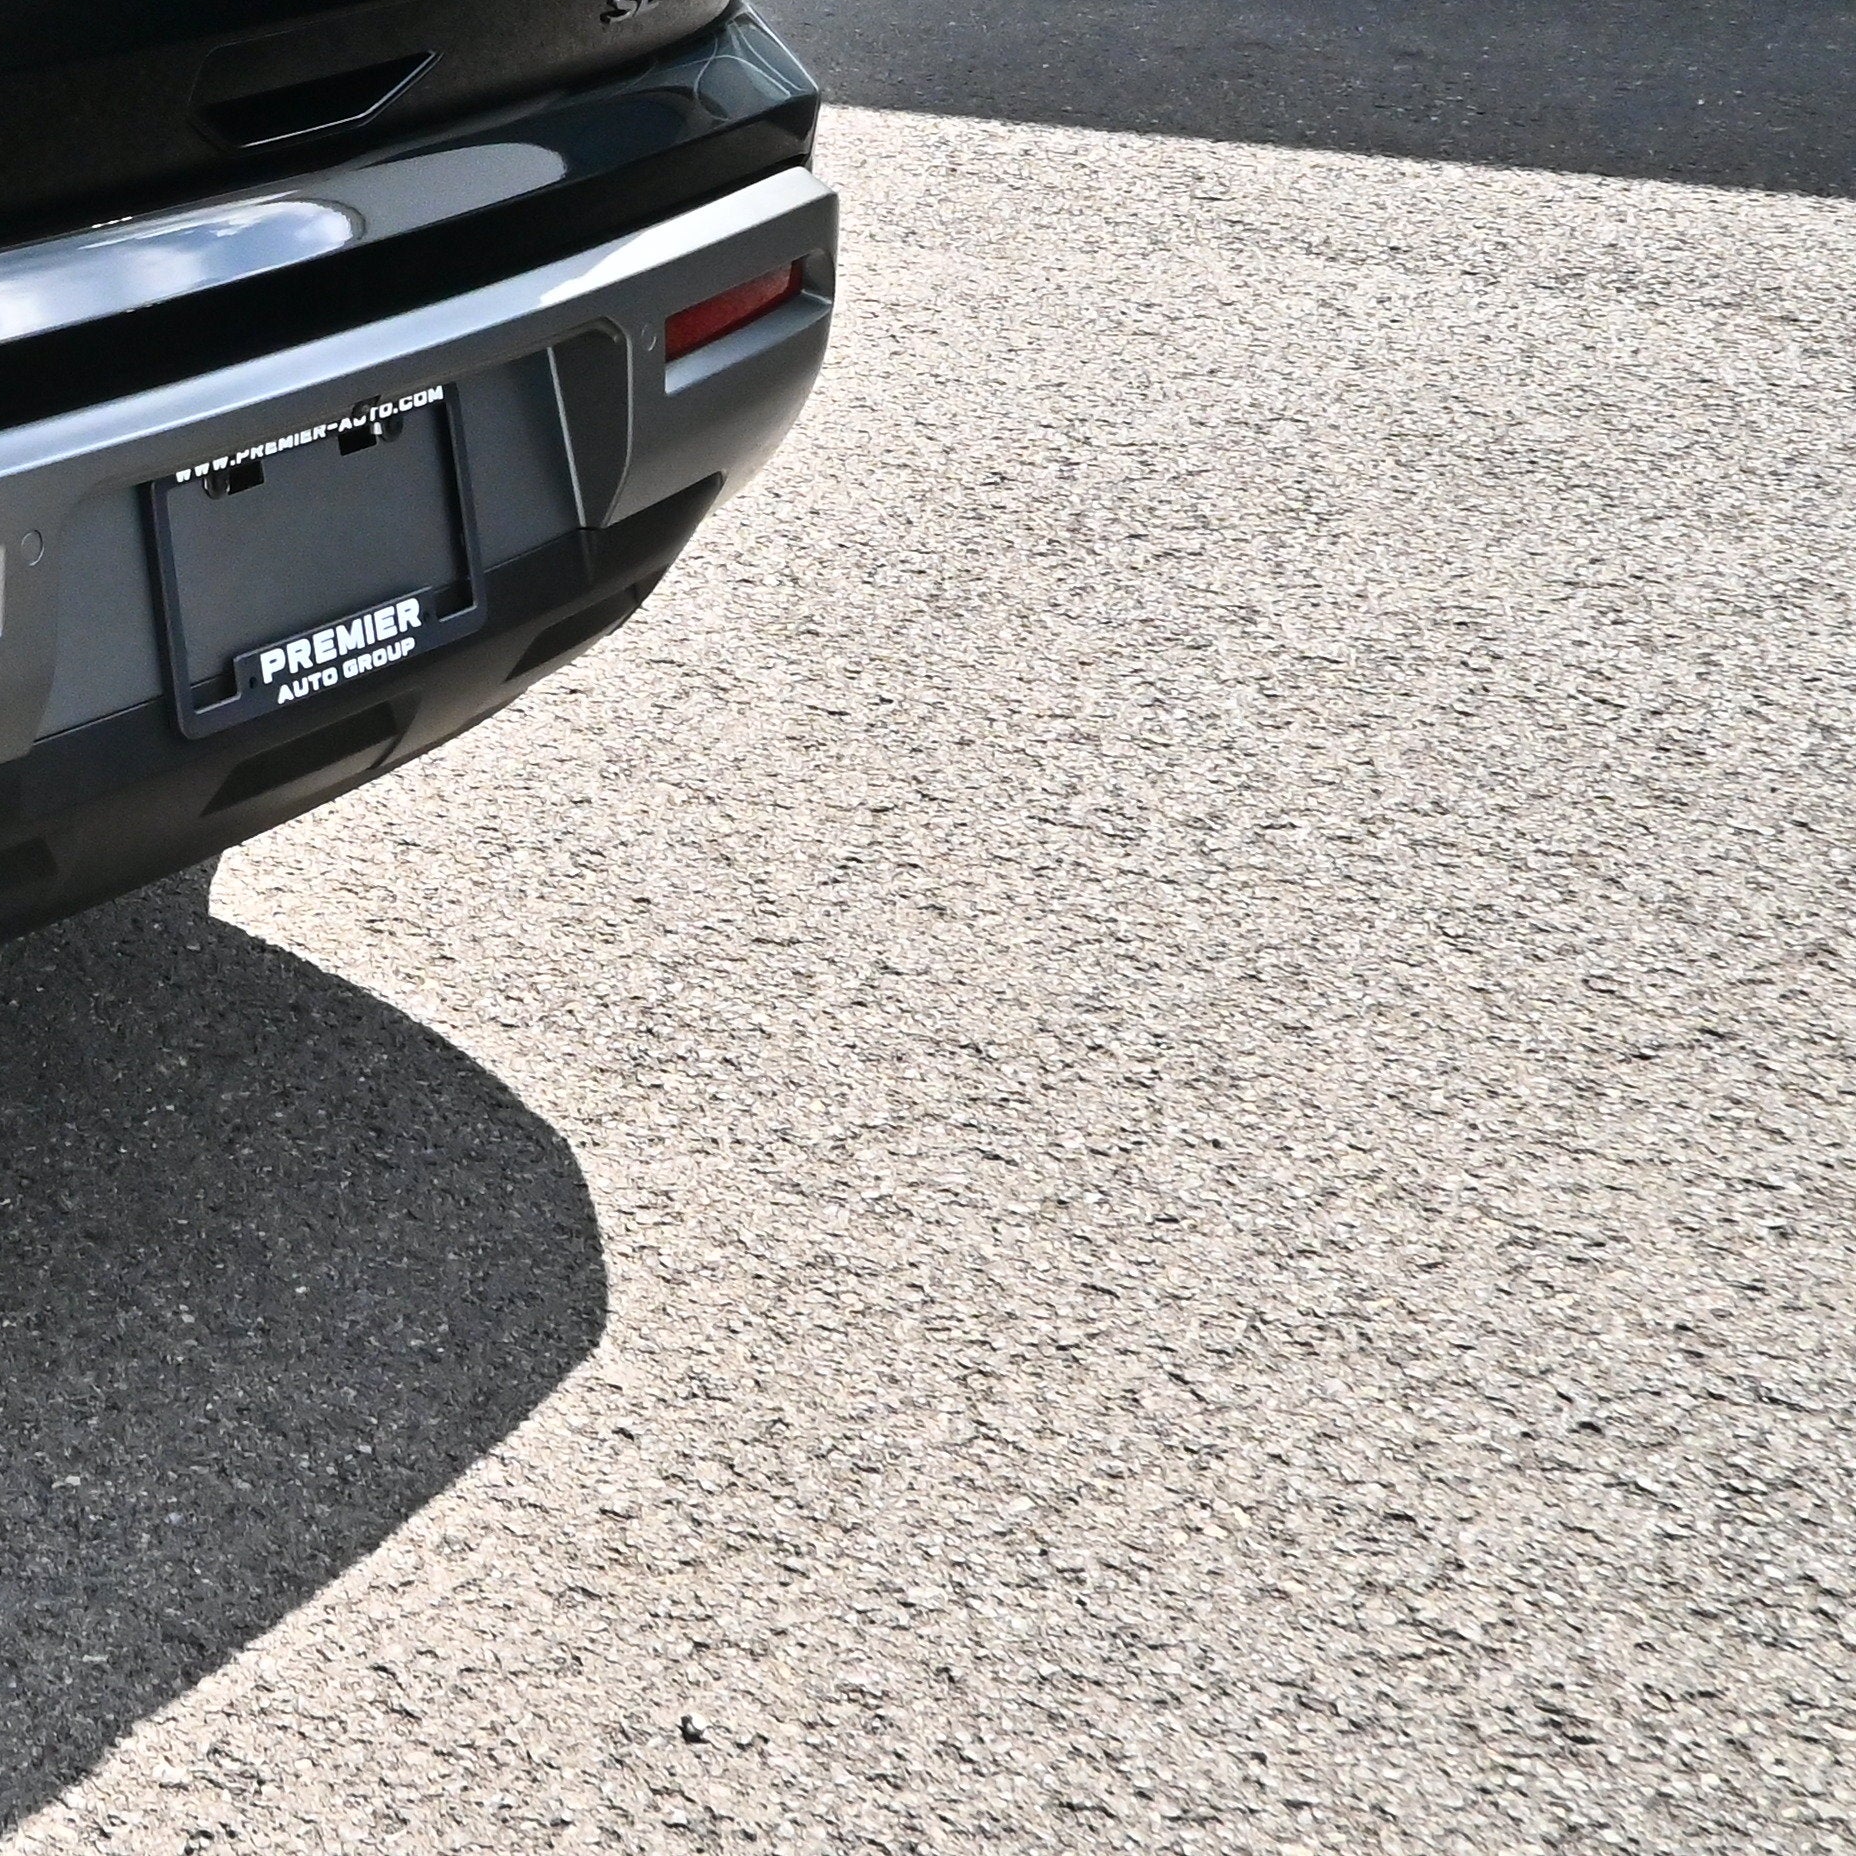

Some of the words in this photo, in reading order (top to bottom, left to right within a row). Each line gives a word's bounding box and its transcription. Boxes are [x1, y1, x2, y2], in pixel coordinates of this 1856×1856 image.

[259, 597, 422, 685] PREMIER
[277, 666, 339, 705] AUTO
[342, 636, 416, 679] GROUP
